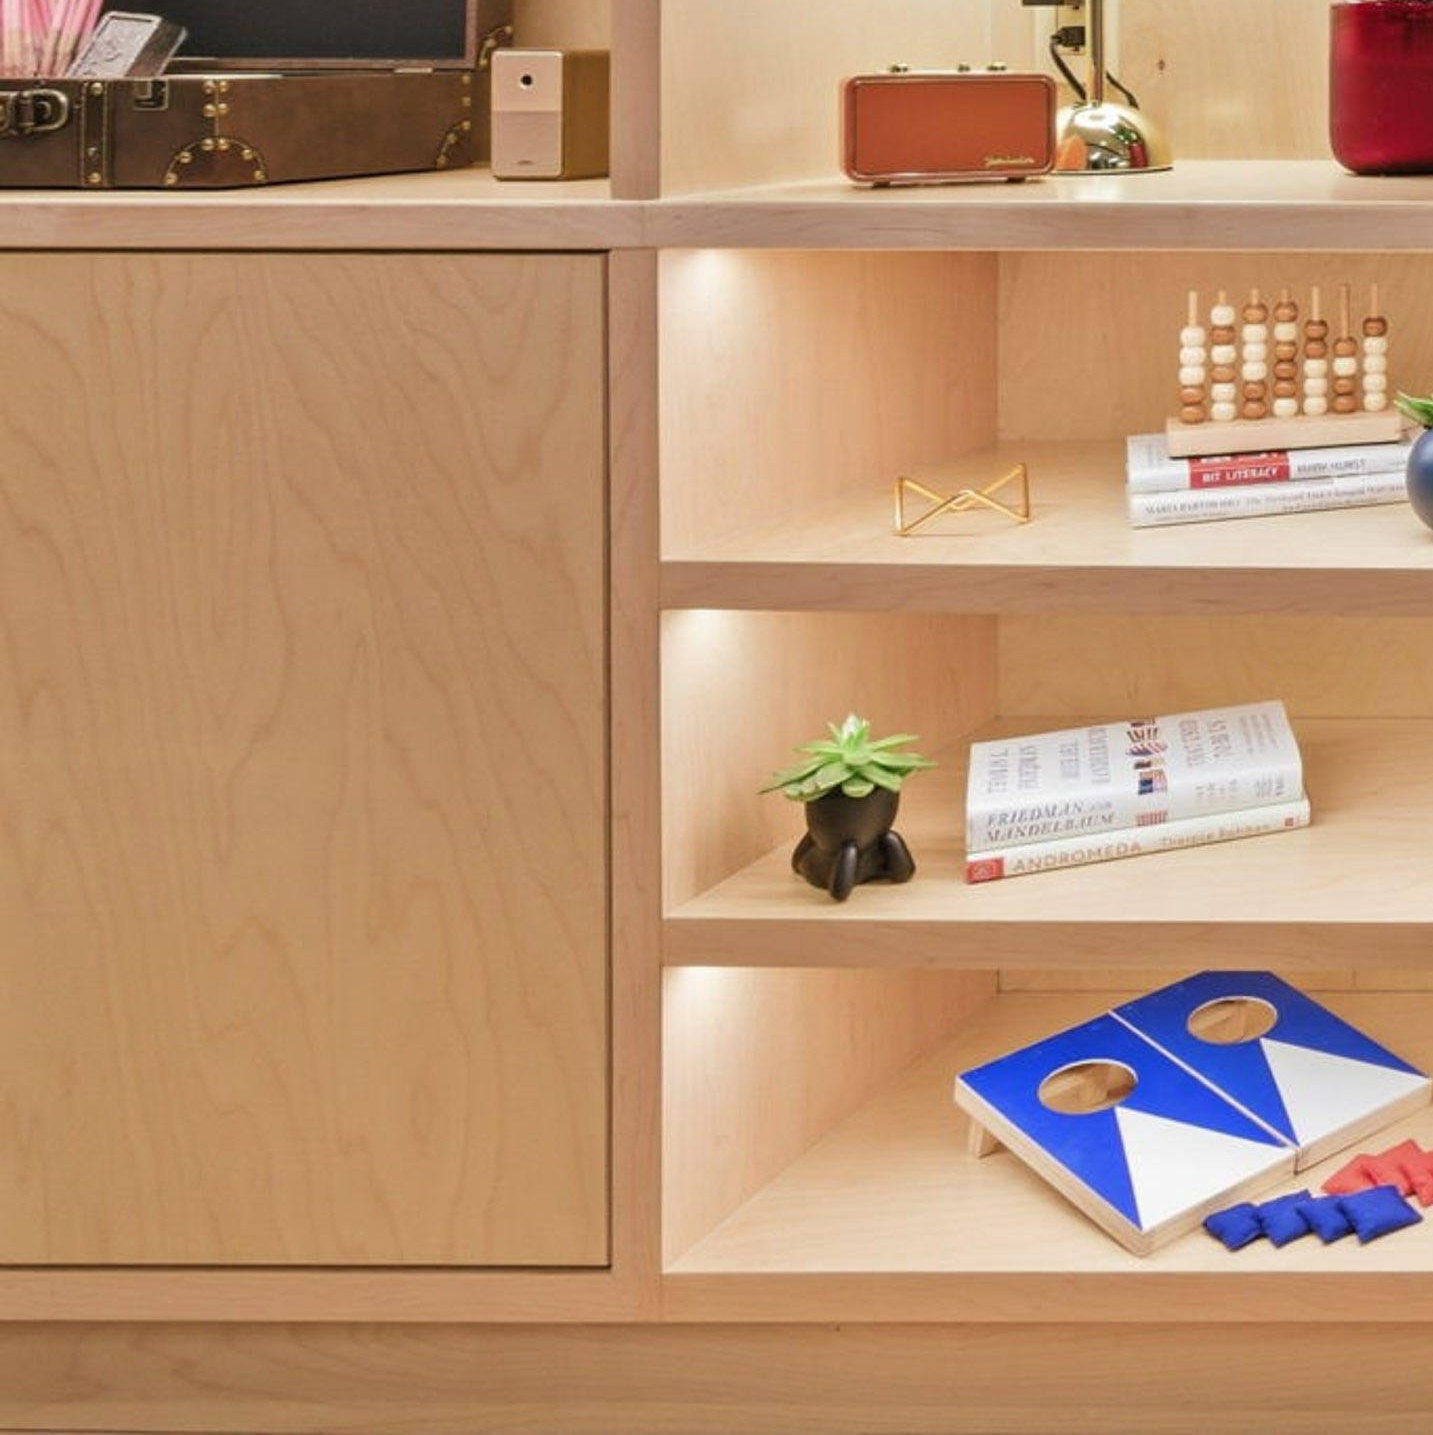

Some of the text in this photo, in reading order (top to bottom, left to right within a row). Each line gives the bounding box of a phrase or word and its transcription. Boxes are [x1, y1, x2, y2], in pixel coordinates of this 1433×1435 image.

[1226, 467, 1278, 482] LITERACY
[987, 801, 1082, 826] FRIEDMAN
[984, 814, 1114, 843] MANDELBAUM
[1015, 841, 1143, 874] ANDROMEDA
